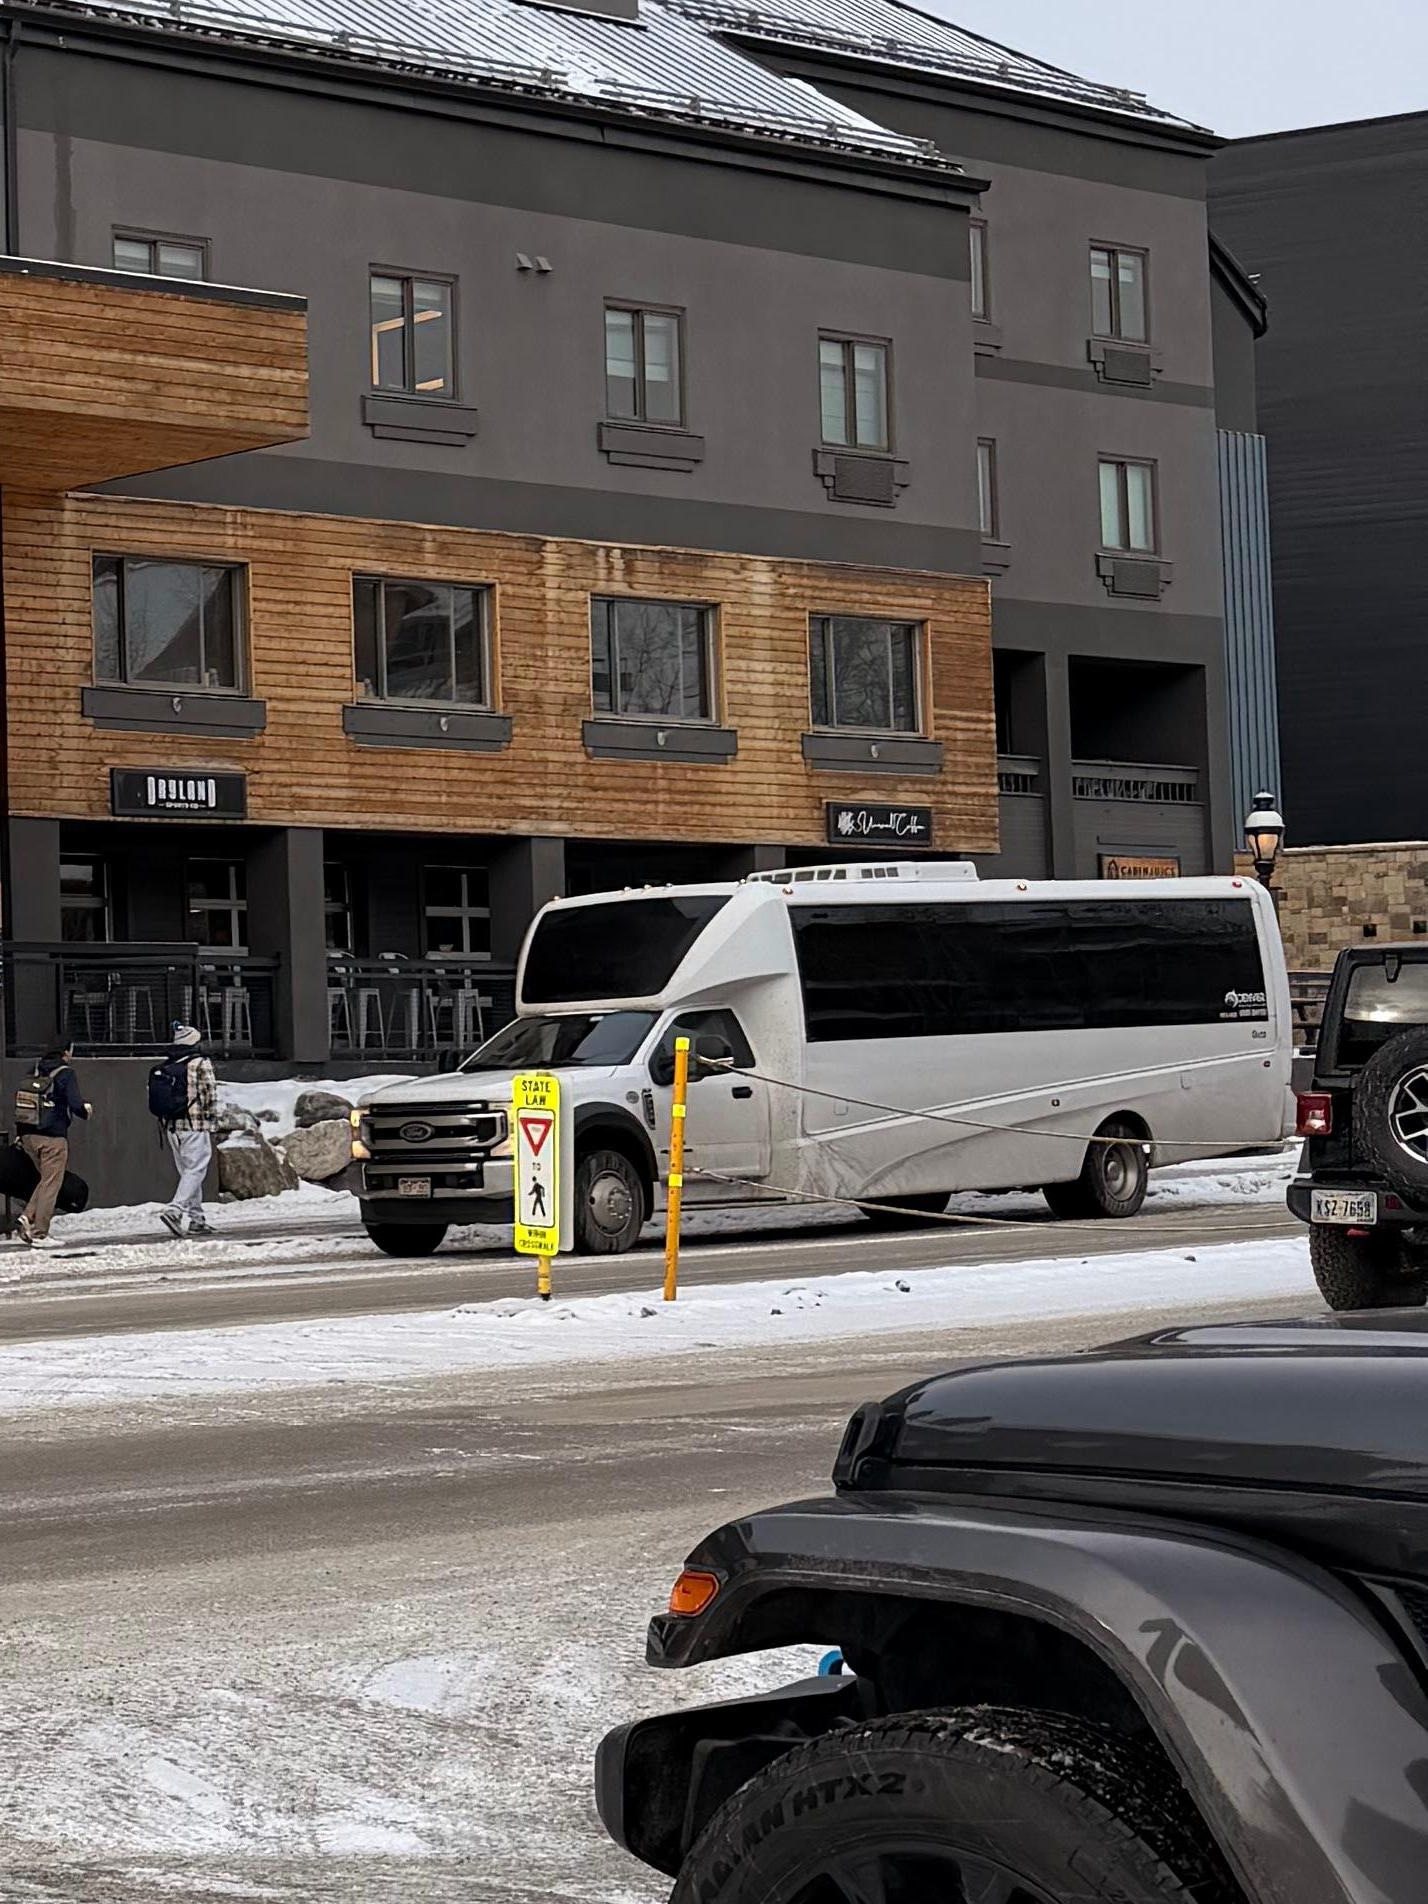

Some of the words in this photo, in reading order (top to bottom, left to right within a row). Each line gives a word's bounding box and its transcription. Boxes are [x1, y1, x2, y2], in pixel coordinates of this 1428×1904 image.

[147, 776, 216, 807] DRYLAND
[521, 1080, 551, 1093] STATE
[526, 1094, 547, 1106] LAW
[793, 1771, 906, 1818] HTX2
